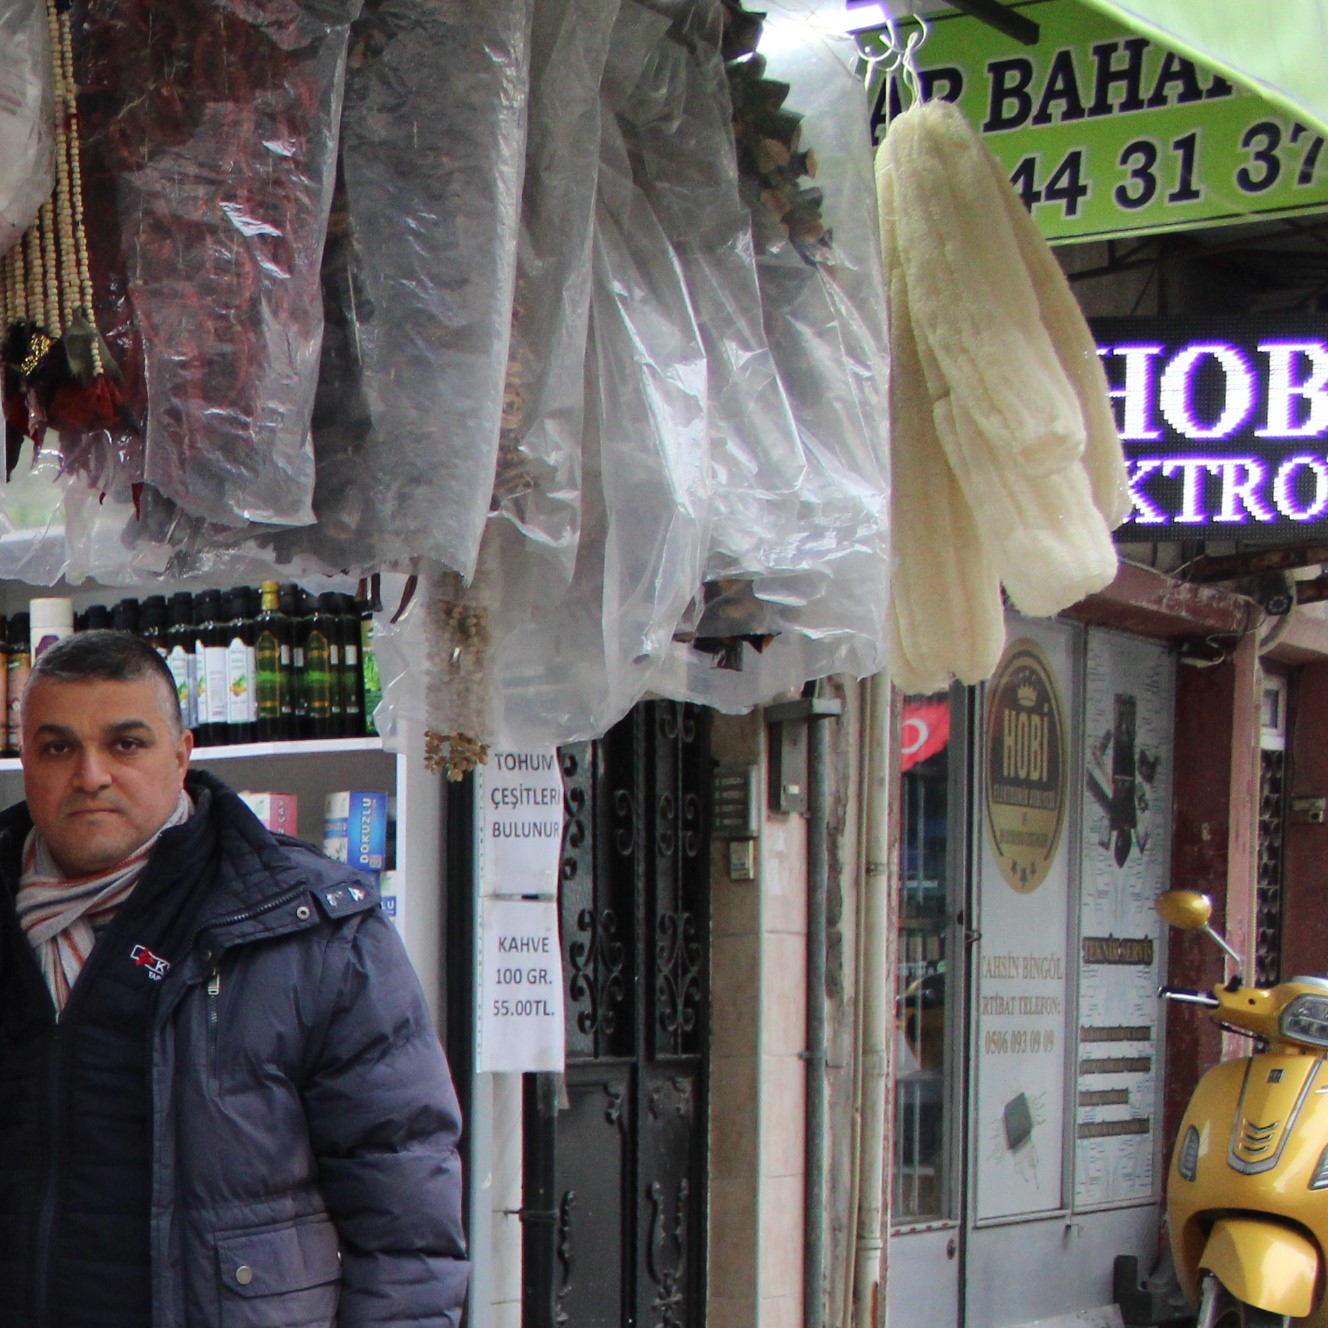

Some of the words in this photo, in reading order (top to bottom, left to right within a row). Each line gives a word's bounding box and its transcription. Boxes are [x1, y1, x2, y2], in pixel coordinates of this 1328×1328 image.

[982, 38, 1233, 133] BAHA
[1114, 132, 1201, 209] 31
[1236, 120, 1325, 194] 37
[360, 797, 372, 864] DOKUZLU
[492, 820, 560, 838] BULUNUR
[499, 936, 550, 953] KAHVE
[496, 968, 522, 985] 100
[527, 968, 552, 985] GR.
[982, 993, 1015, 1016] RTİBAT
